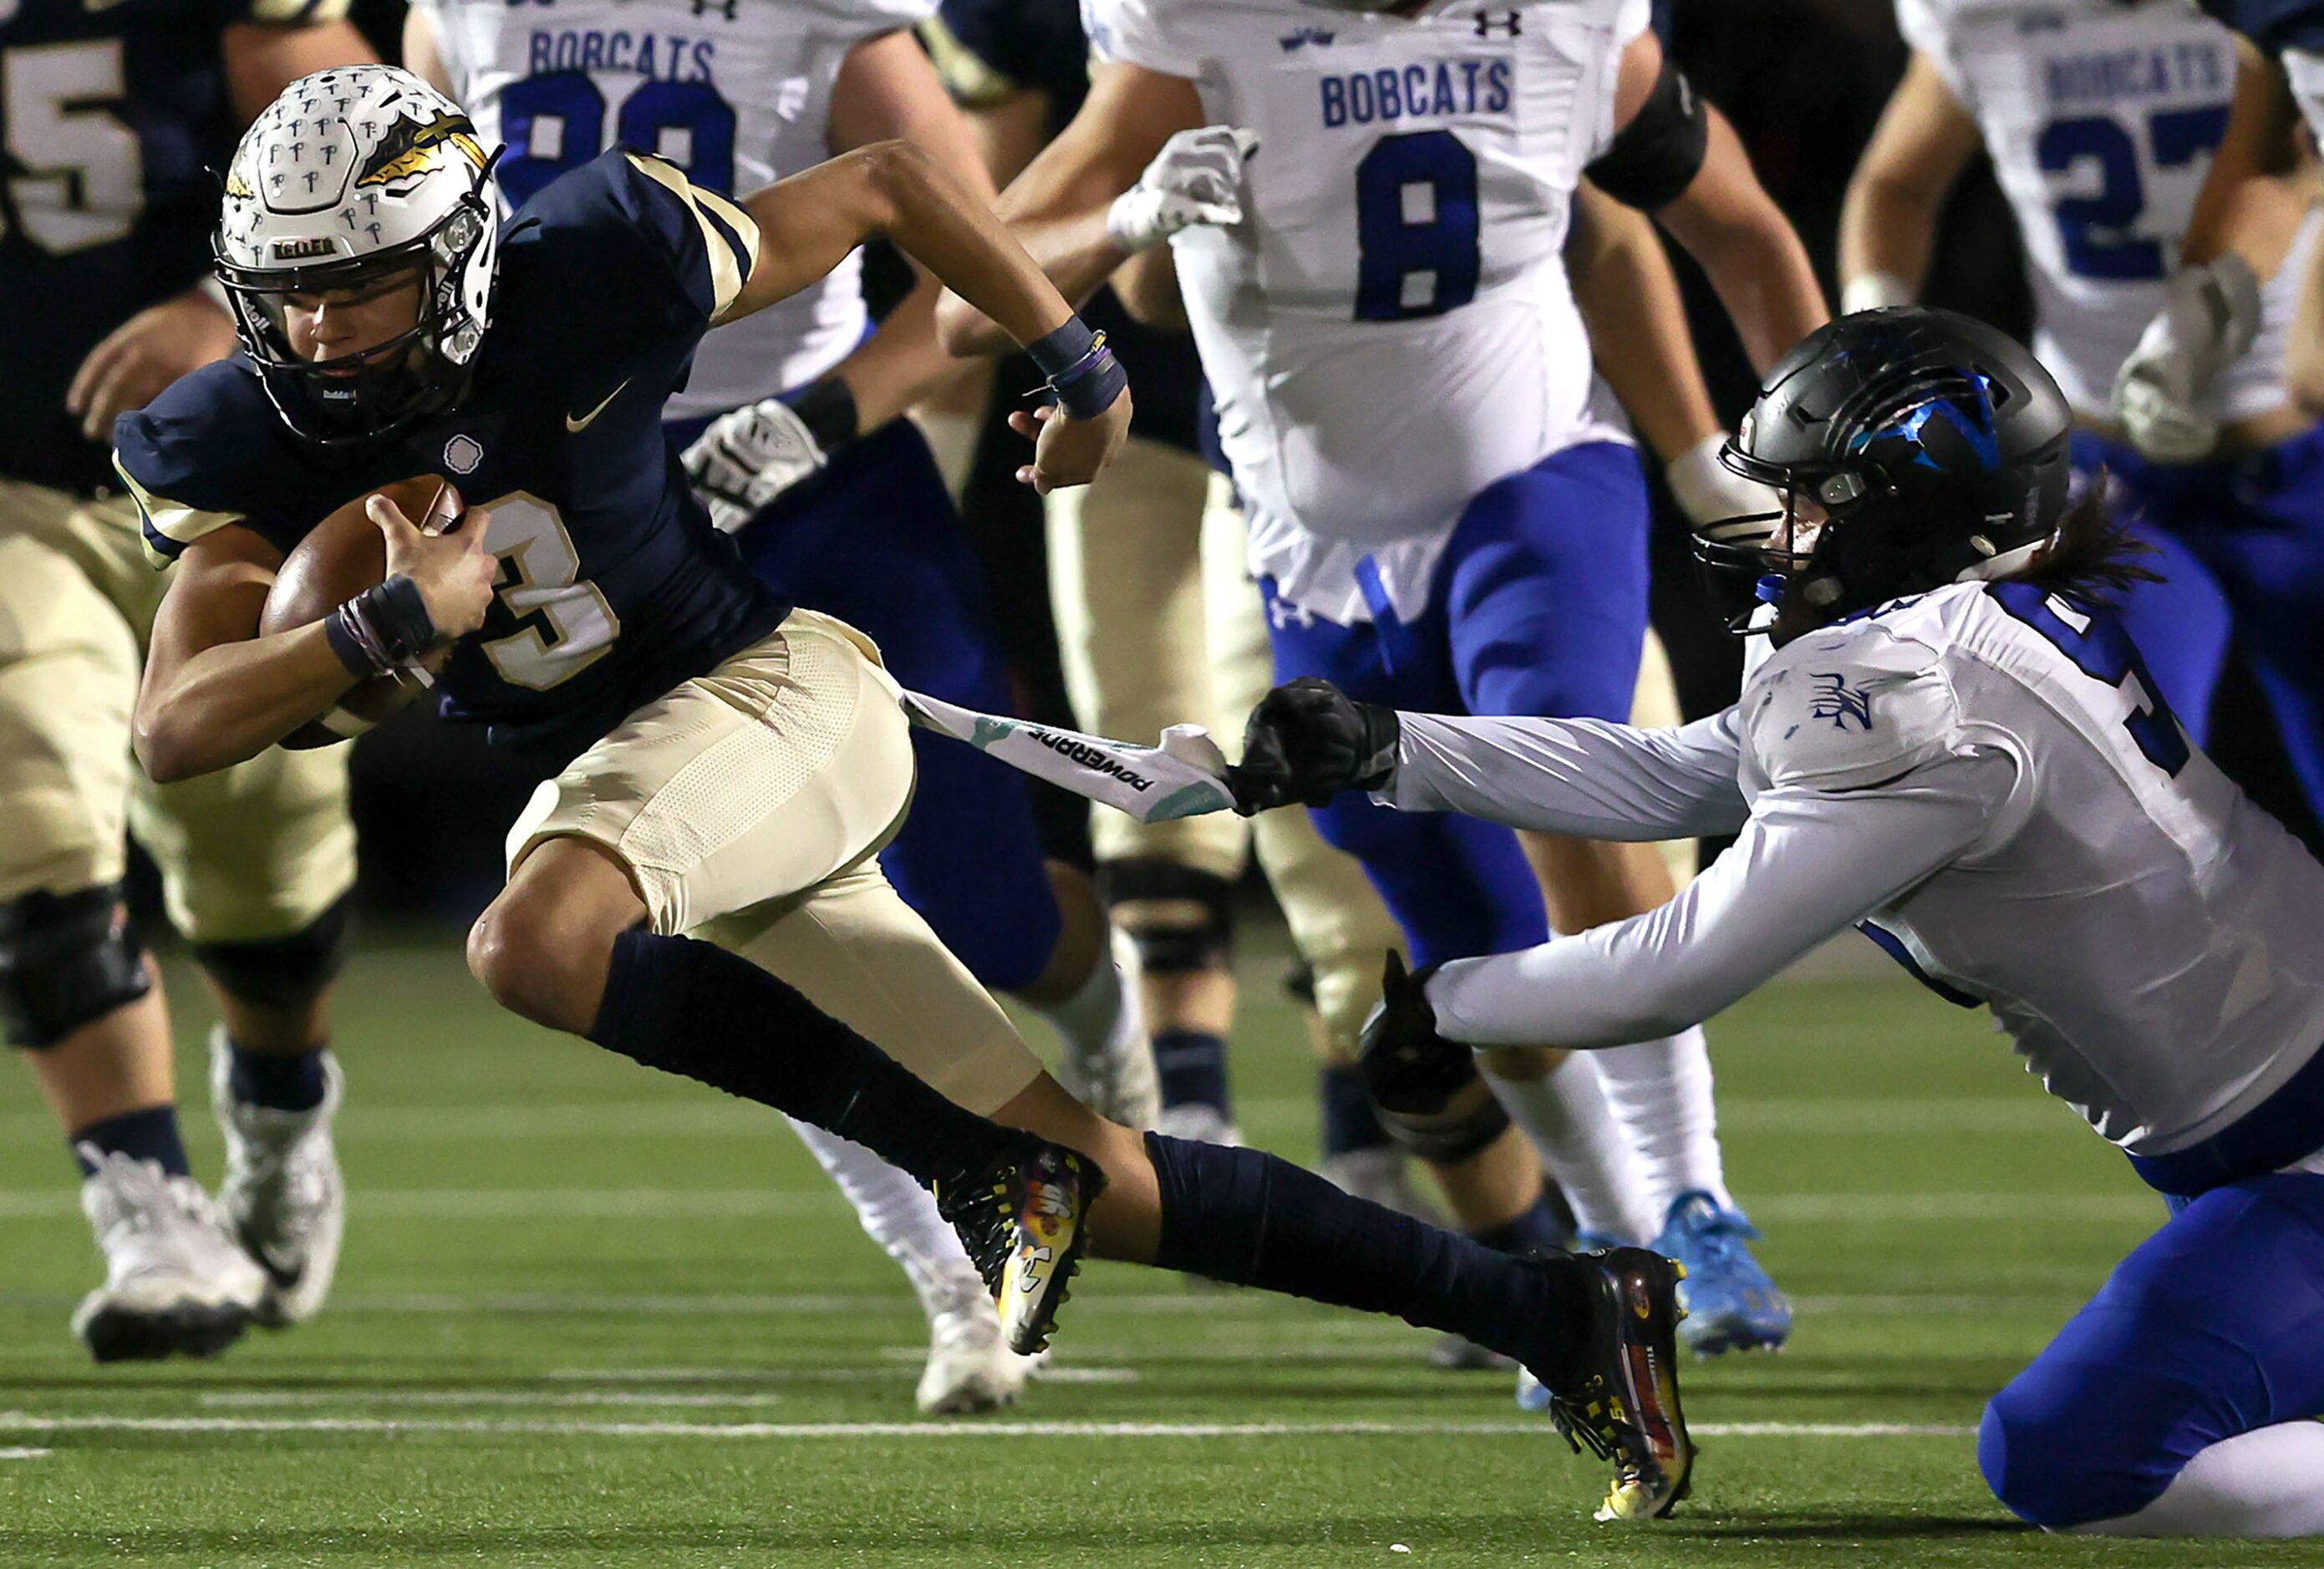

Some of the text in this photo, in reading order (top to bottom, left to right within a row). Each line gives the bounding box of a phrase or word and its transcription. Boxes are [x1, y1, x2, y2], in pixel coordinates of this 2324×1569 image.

[530, 29, 714, 84] BOBCATS
[1320, 59, 1510, 129] BOBCATS
[1353, 129, 1481, 322] 8
[470, 489, 622, 692] 3
